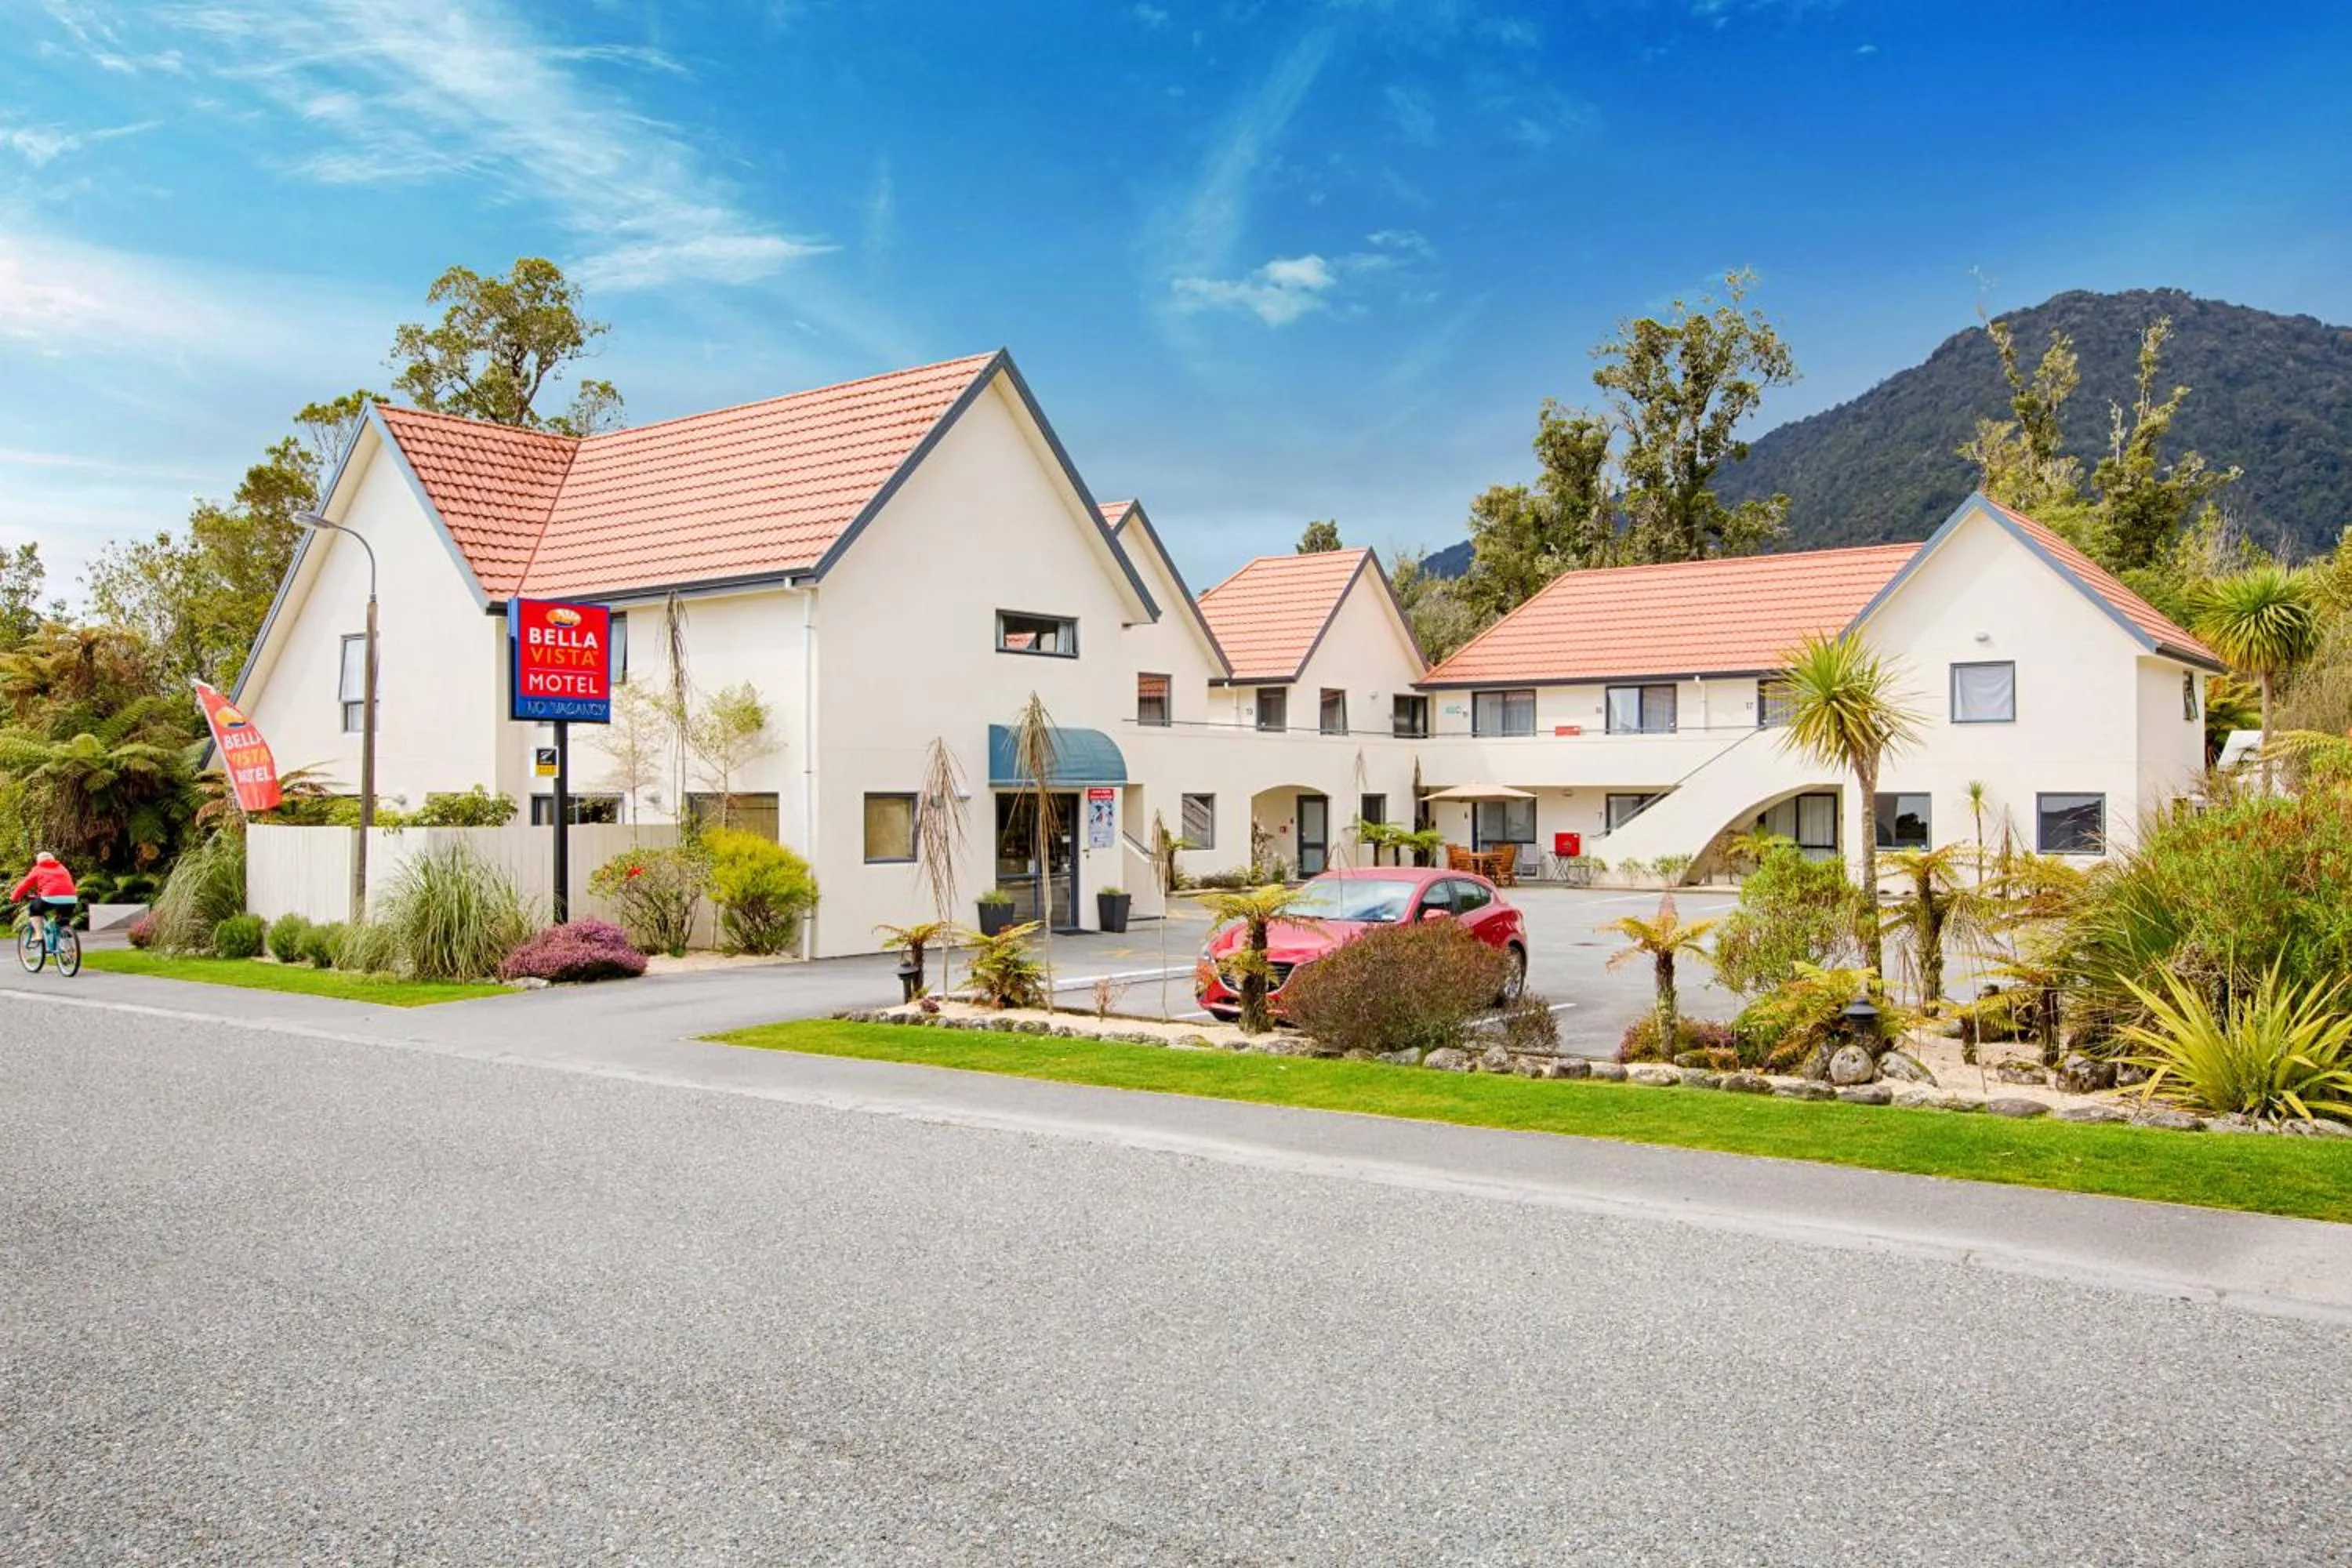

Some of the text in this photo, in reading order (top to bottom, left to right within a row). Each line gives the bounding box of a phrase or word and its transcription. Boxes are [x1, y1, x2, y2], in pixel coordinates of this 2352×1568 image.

[529, 626, 599, 648] BELLA
[530, 647, 597, 666] VISTA
[528, 673, 599, 694] MOTEL
[527, 700, 546, 715] NO
